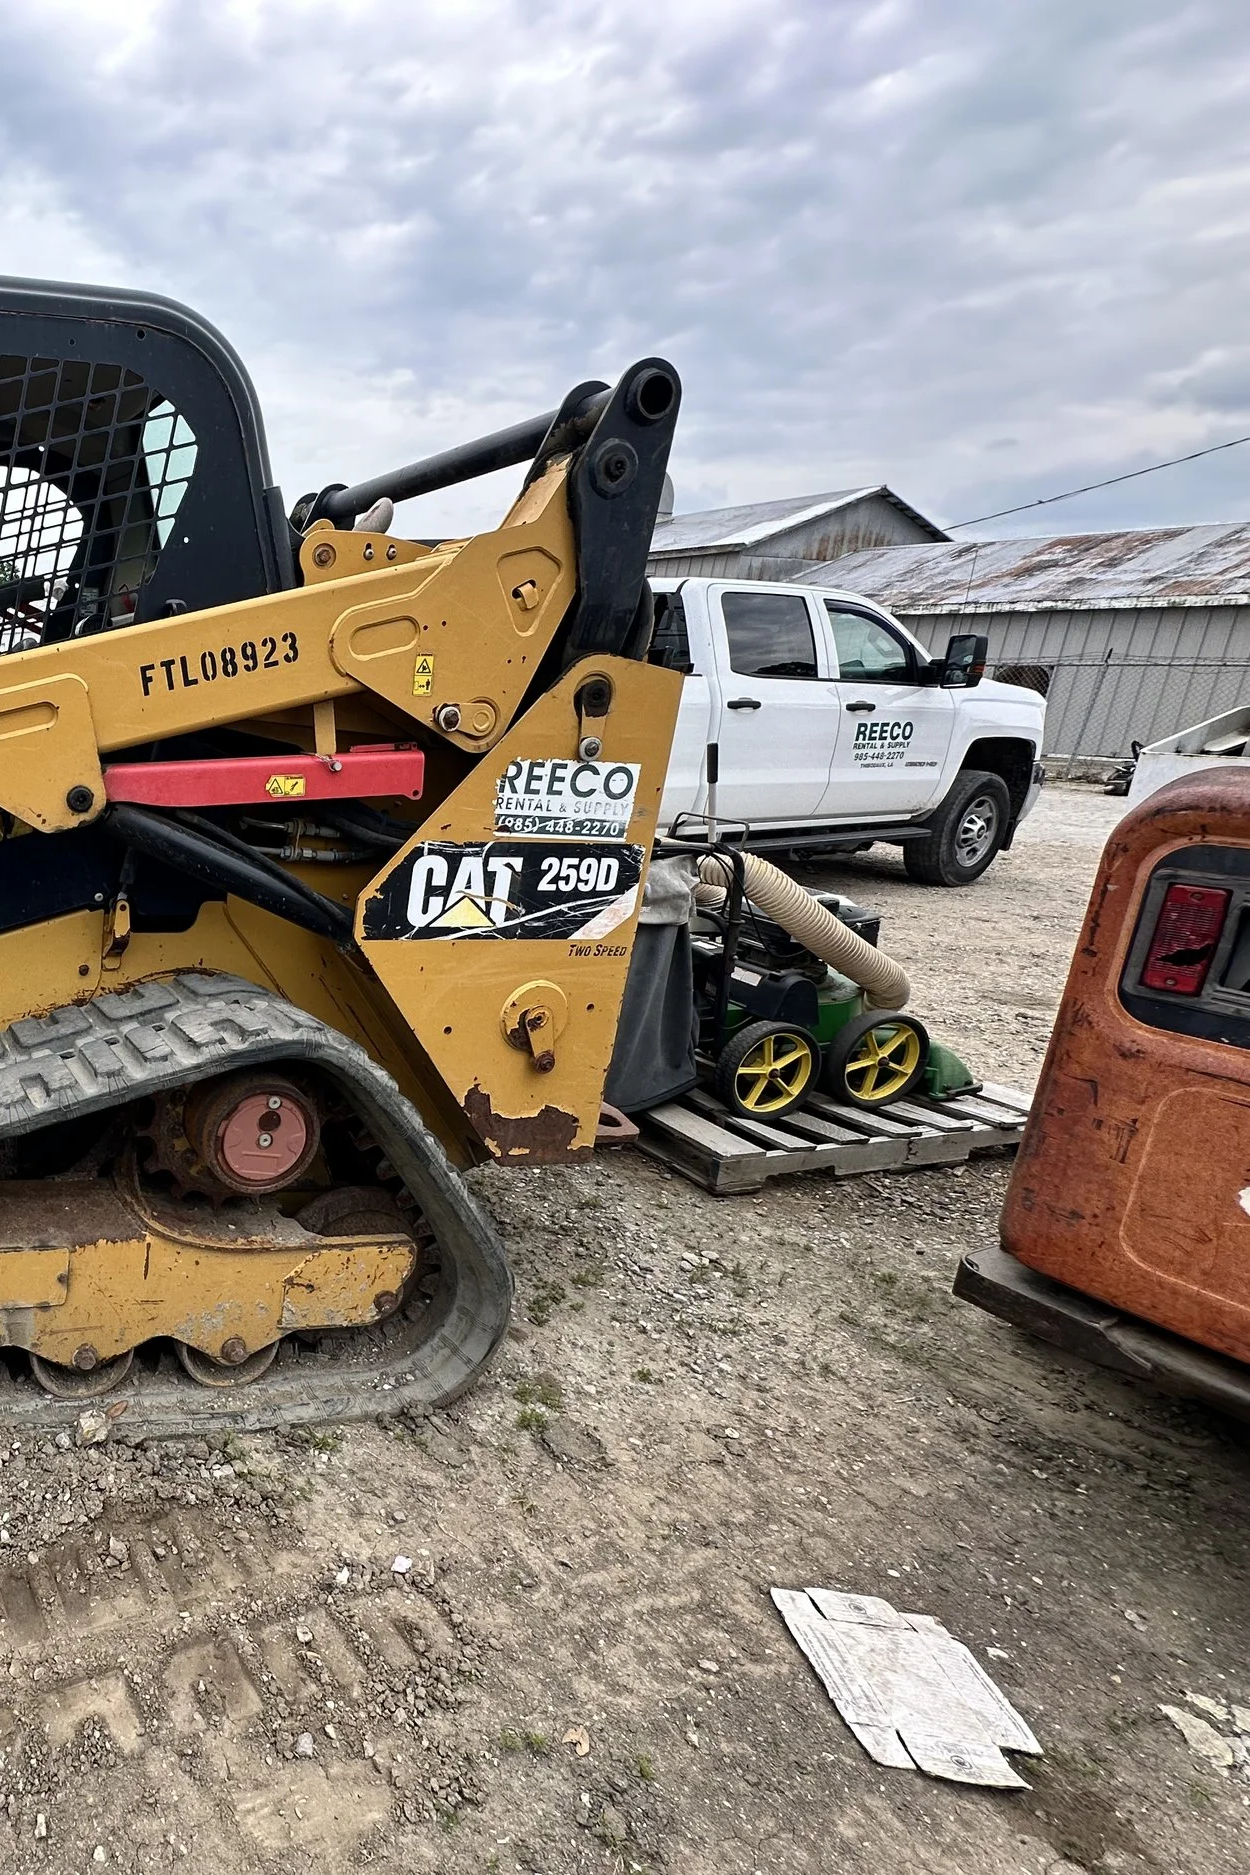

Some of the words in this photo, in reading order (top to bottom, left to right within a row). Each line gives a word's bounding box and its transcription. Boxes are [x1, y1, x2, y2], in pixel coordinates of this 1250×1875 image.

[139, 631, 299, 697] FTL08923
[854, 721, 914, 741] REECO
[852, 742, 878, 750] RENTAL
[887, 741, 911, 749] SUPPLY
[853, 751, 905, 761] 985-448-2270
[498, 761, 634, 801] REECO
[495, 796, 553, 812] RENTAL
[558, 804, 567, 813] &
[573, 800, 629, 816] SUPPLY
[498, 815, 539, 833] (985)
[545, 819, 620, 836] 448-2270
[406, 854, 524, 928] CAT
[536, 856, 620, 892] 259D
